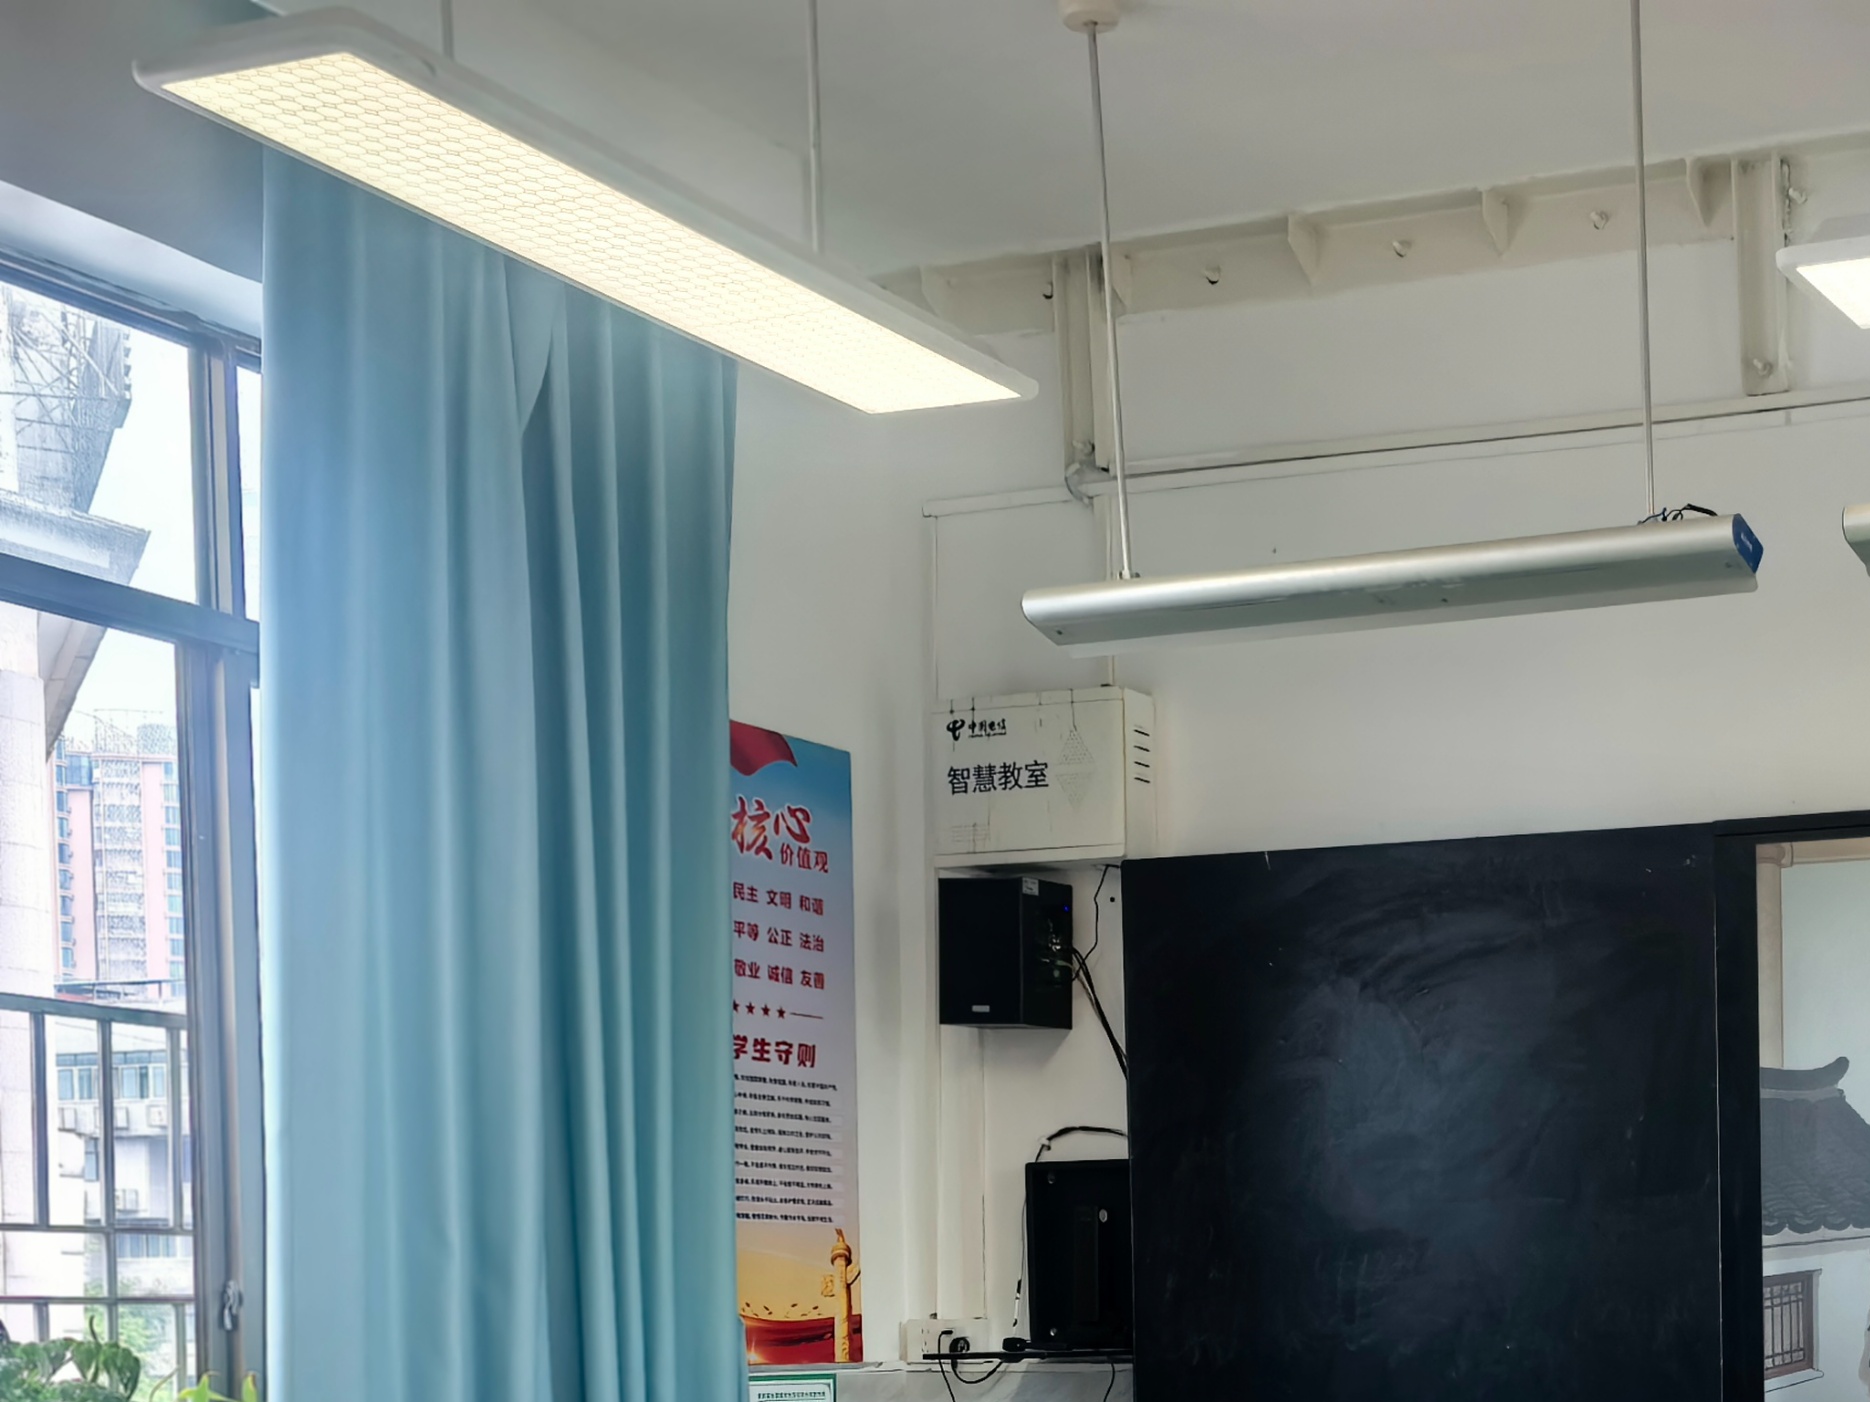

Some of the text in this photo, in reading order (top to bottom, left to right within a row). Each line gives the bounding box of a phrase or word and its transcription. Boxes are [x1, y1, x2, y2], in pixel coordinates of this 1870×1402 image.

[947, 759, 1049, 796] 智慧教室
[731, 795, 812, 861] 核心
[780, 842, 829, 874] 价值观
[733, 881, 824, 916] 民主 文明 和谐
[733, 920, 825, 953] 平等 公正 法治
[734, 958, 825, 990] 敬业 诚信 友善
[732, 1034, 816, 1069] 学生守则
